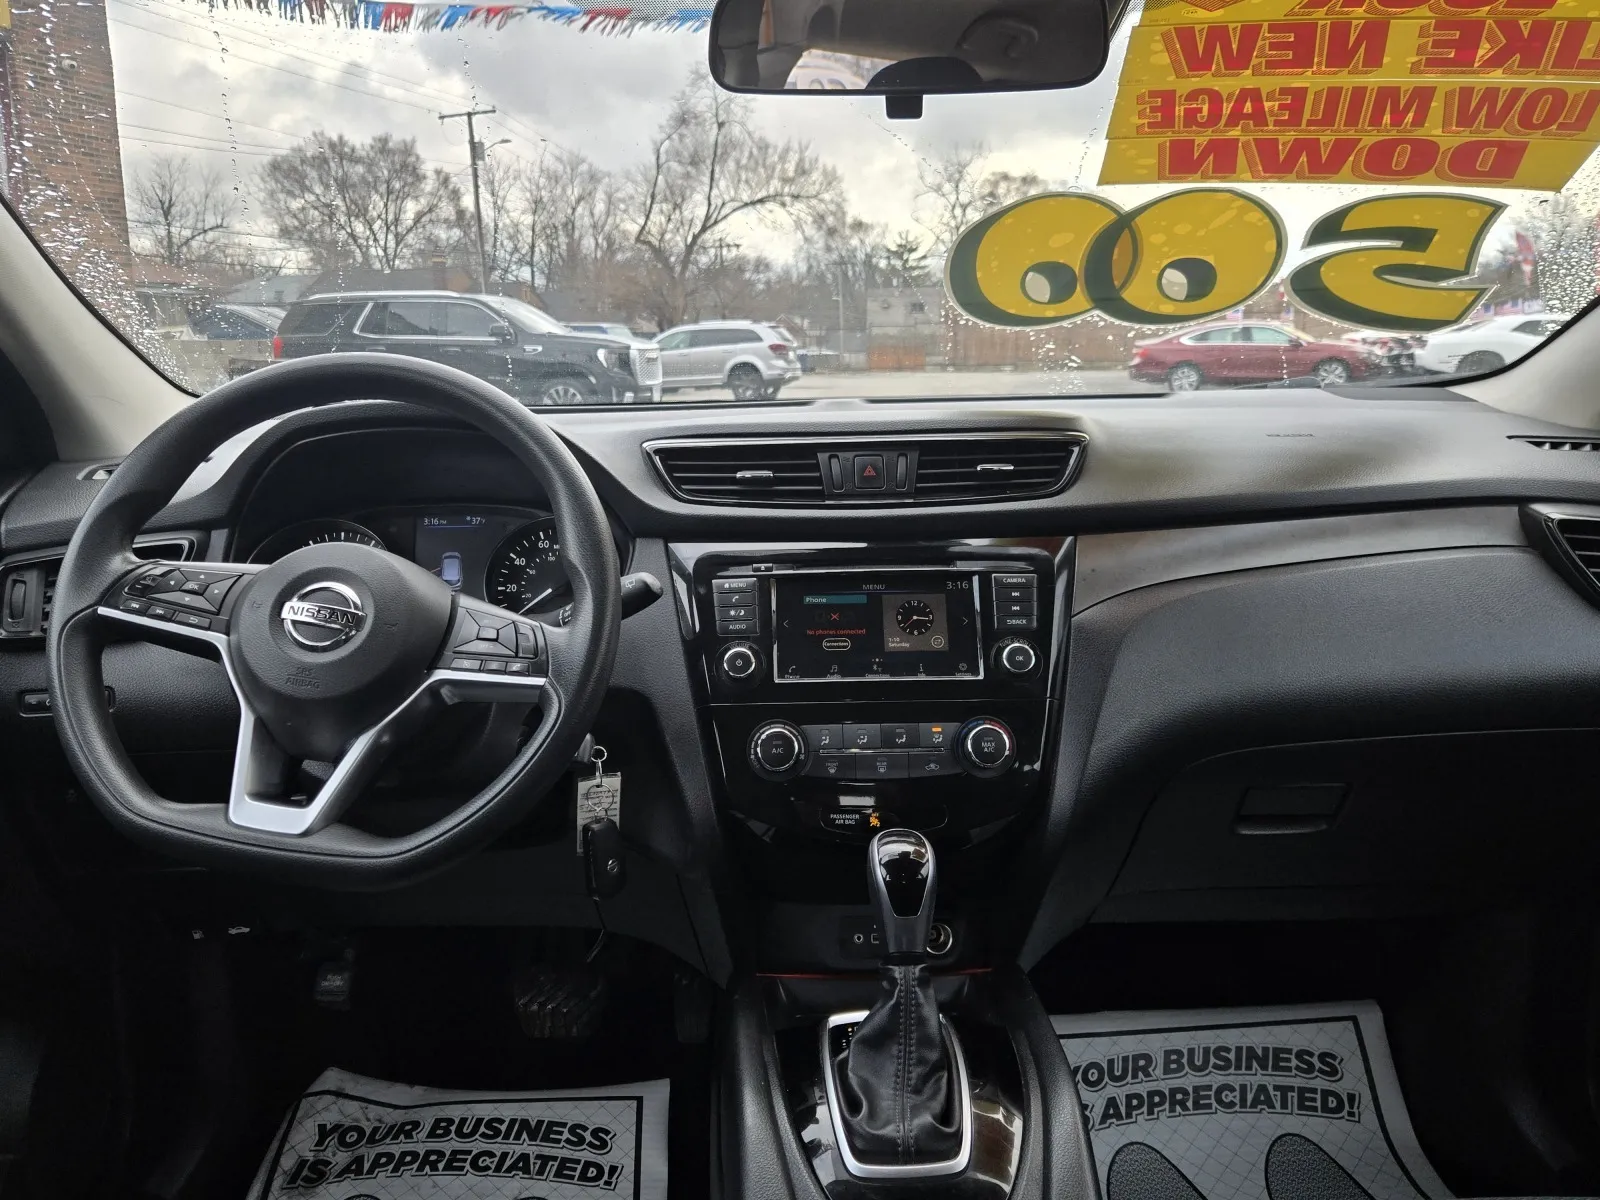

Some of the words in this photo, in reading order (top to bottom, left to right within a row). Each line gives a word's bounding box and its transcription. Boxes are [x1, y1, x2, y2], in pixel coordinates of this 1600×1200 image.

[424, 517, 439, 526] 3:16
[538, 541, 549, 549] 60
[514, 558, 526, 566] 40
[506, 584, 517, 592] 20
[946, 581, 969, 590] 3:16
[287, 605, 357, 626] NISSAN
[285, 677, 321, 689] AIRBAG
[1162, 1045, 1342, 1082] BUSINESS
[1098, 1083, 1360, 1128] APPRECIATED!
[312, 1119, 424, 1151] YOUR
[425, 1116, 615, 1154] BUSINESS
[284, 1157, 336, 1188] IS
[334, 1149, 624, 1190] APPRECIATED!
